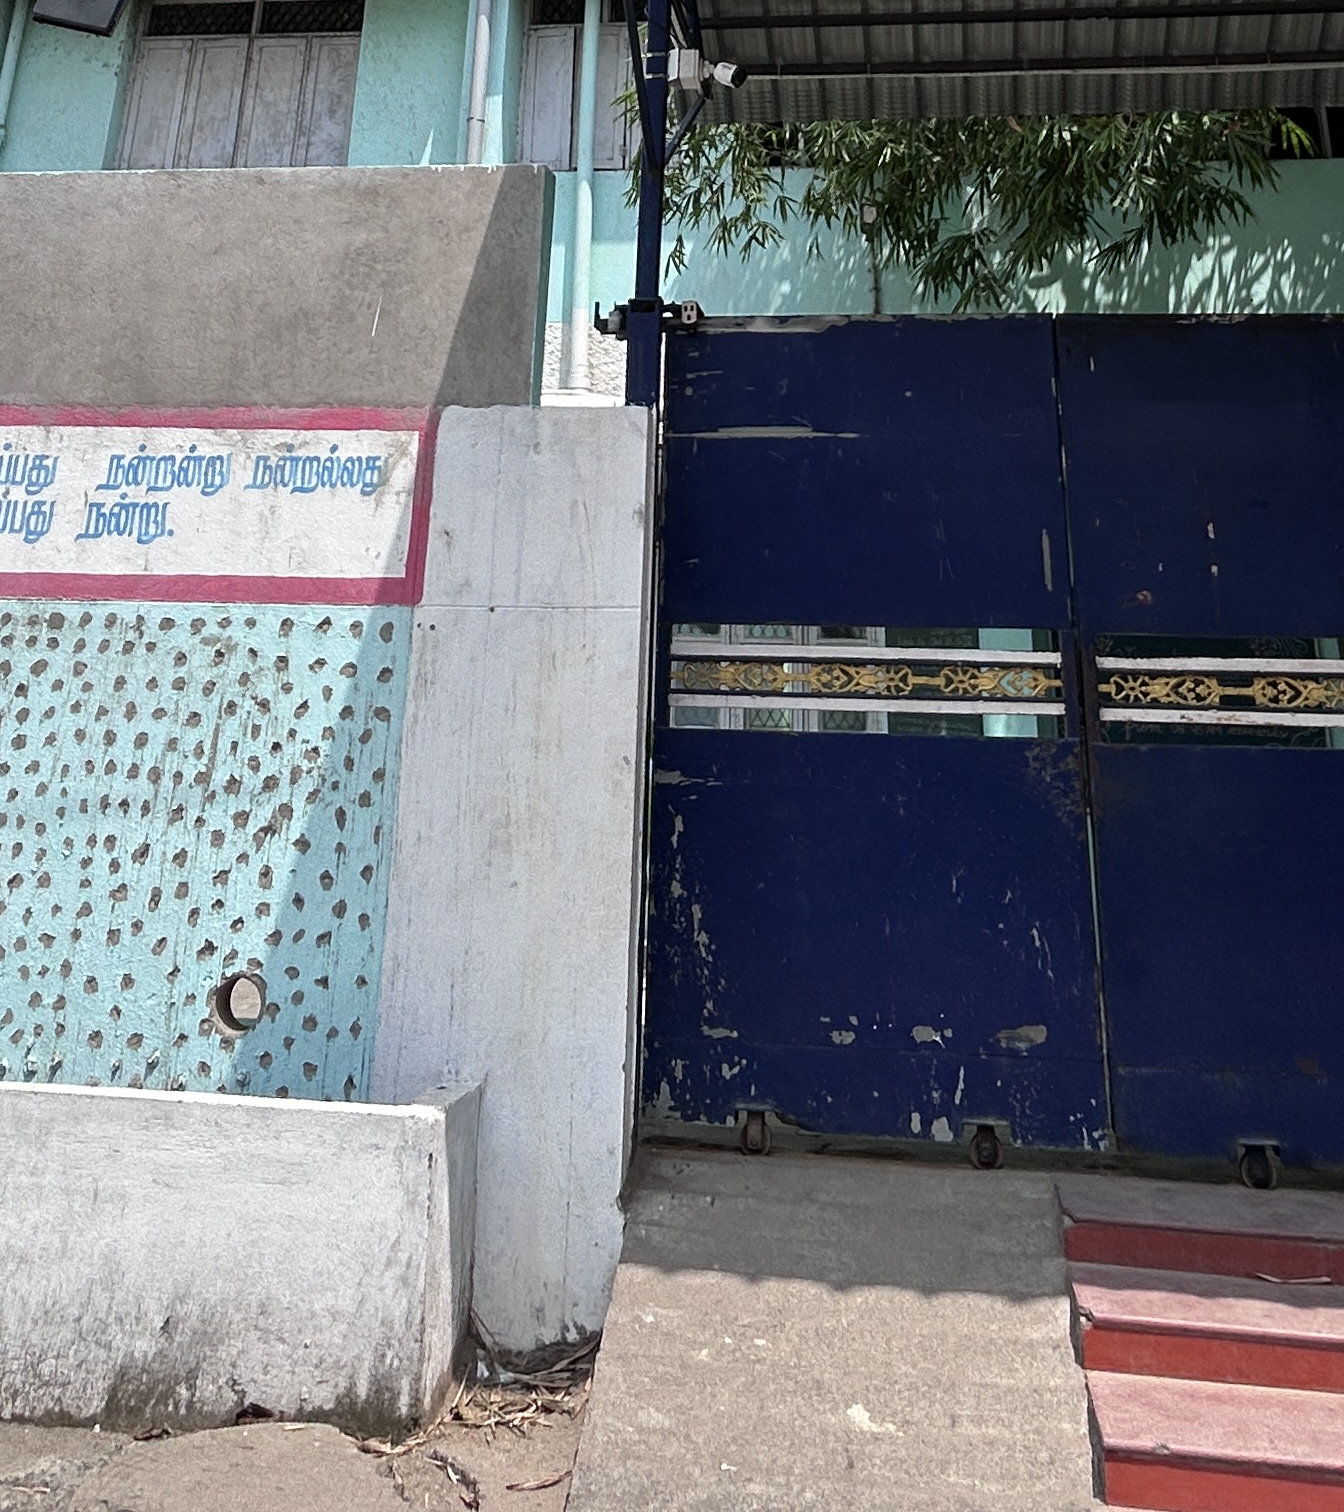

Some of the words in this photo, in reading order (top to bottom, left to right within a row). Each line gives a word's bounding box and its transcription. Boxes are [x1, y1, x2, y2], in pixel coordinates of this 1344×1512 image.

[94, 444, 233, 496] நன்றன்று
[244, 444, 392, 496] நன்றல்லது
[74, 492, 175, 545] நன்று.
